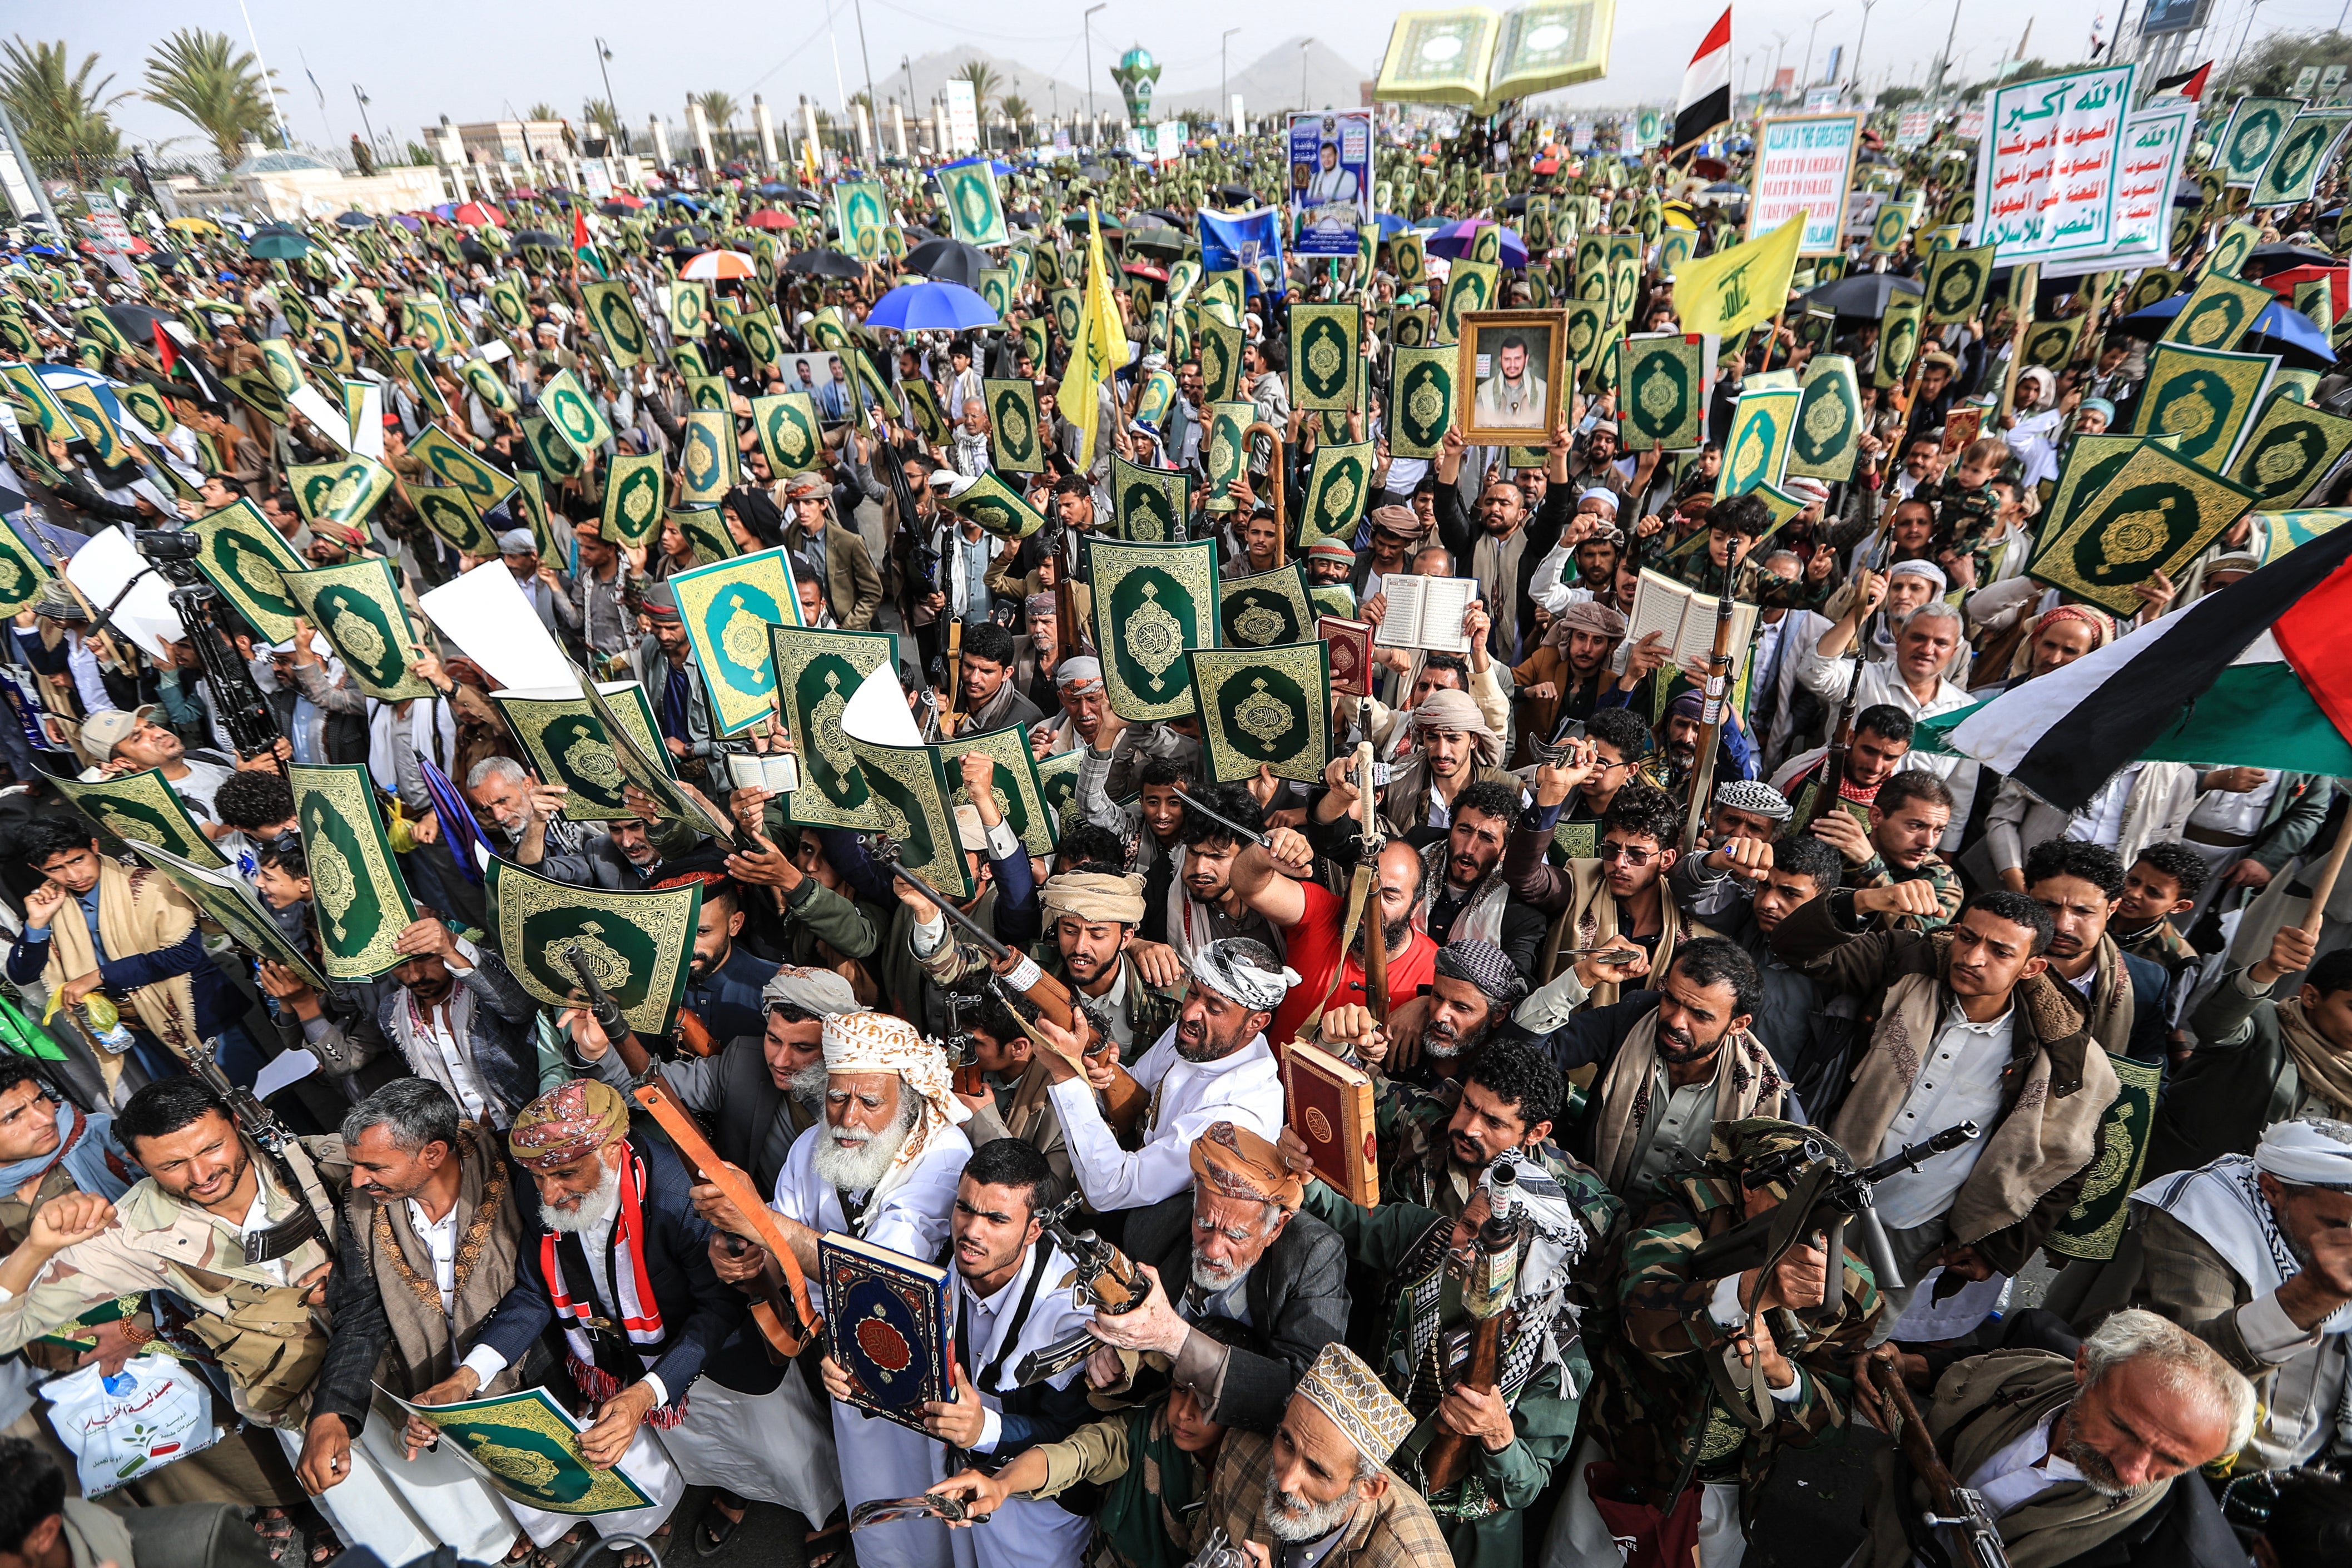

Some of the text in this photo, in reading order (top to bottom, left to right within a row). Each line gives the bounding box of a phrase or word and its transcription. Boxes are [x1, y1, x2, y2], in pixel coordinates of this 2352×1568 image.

[1999, 80, 2076, 133] أكبر
[2074, 78, 2124, 111] الله
[1768, 124, 1853, 150] ALLAH IS THE GREATEST
[1997, 124, 2061, 158] لأمريكا
[2063, 117, 2116, 147] الموت
[2134, 123, 2177, 148] الله
[1765, 156, 1845, 175] DEATH TO AMERICA
[1993, 148, 2110, 191] الموت لإسرائيل
[2124, 152, 2170, 176] الموت
[1762, 178, 1834, 196] DEATH TO ISRAEL
[1990, 178, 2107, 219] اللعنة على اليهود
[2120, 177, 2165, 200] الموت
[2126, 202, 2160, 220] اللعنة
[1807, 225, 1834, 243] ISLAM
[1986, 206, 2103, 250] النصر للإسلام
[2113, 222, 2156, 250] النصر
[84, 1381, 173, 1431] صيدلية المختار
[172, 1438, 212, 1461] Pharmacy
[1625, 1541, 1638, 1552] LTE
